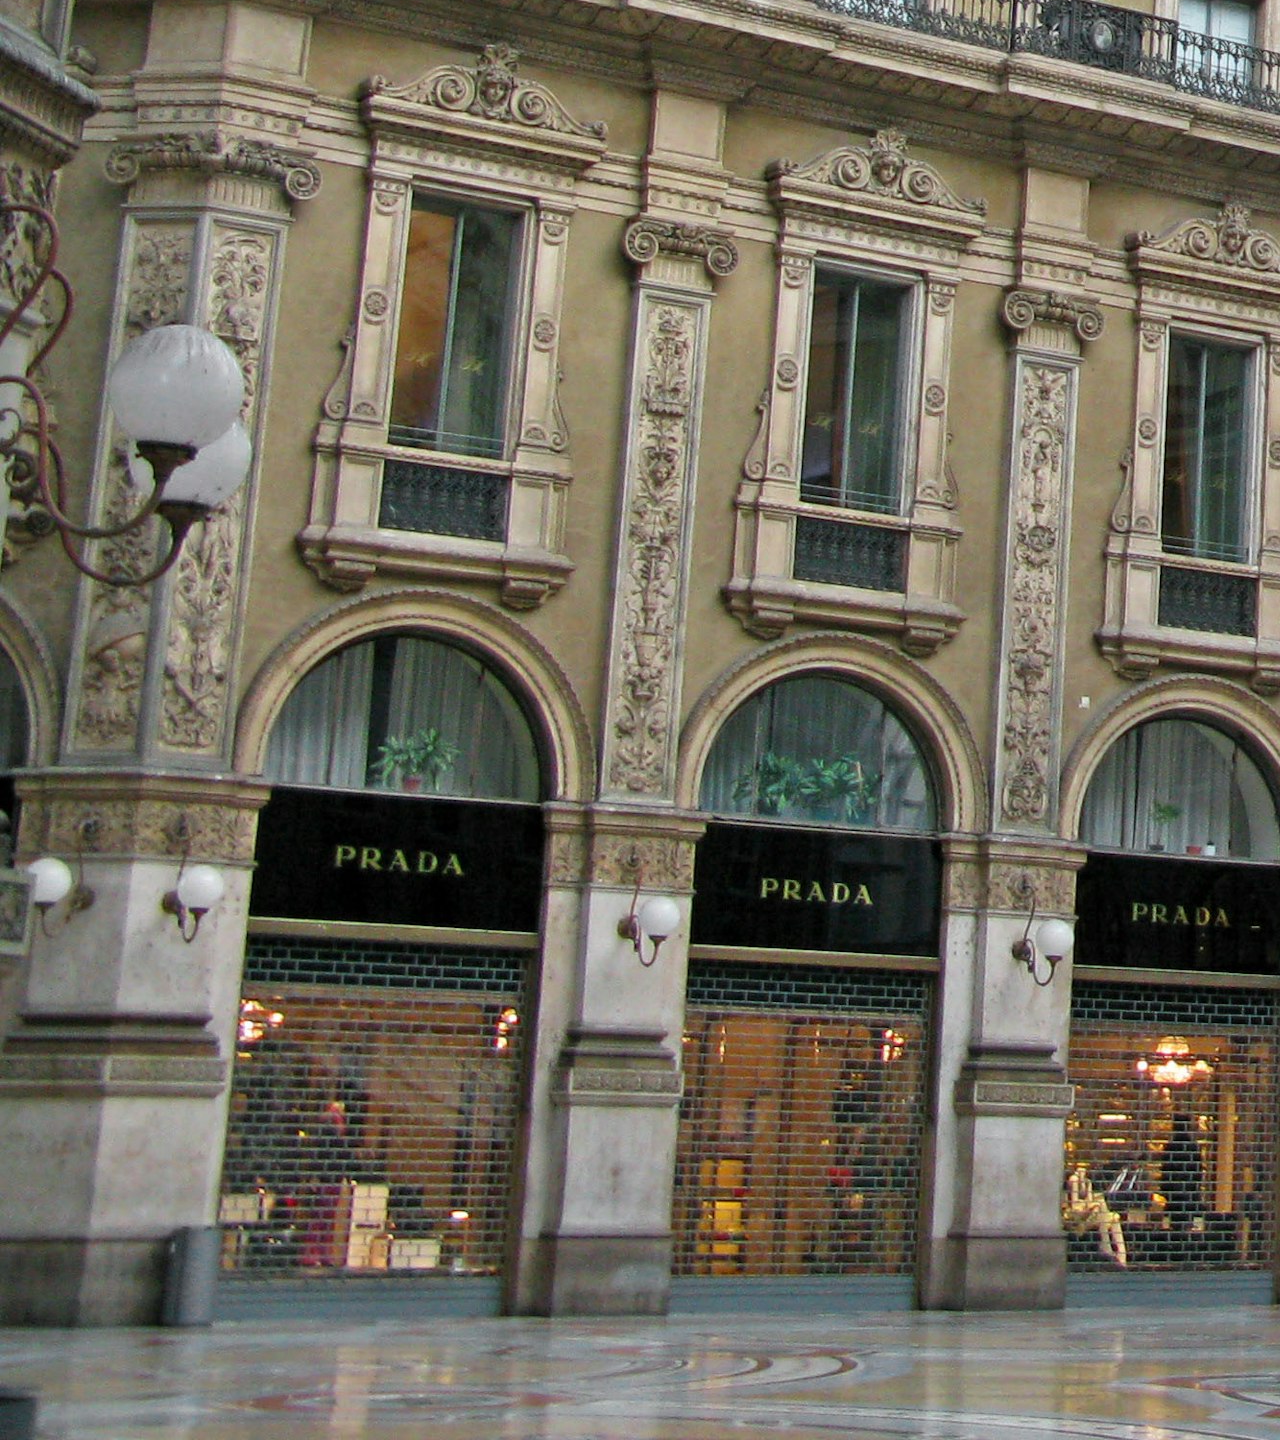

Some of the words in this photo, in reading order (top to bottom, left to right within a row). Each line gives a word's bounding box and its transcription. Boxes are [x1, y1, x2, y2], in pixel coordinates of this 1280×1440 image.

[333, 844, 465, 876] PRADA
[759, 877, 874, 906] PRADA
[1131, 901, 1231, 929] PRADA
